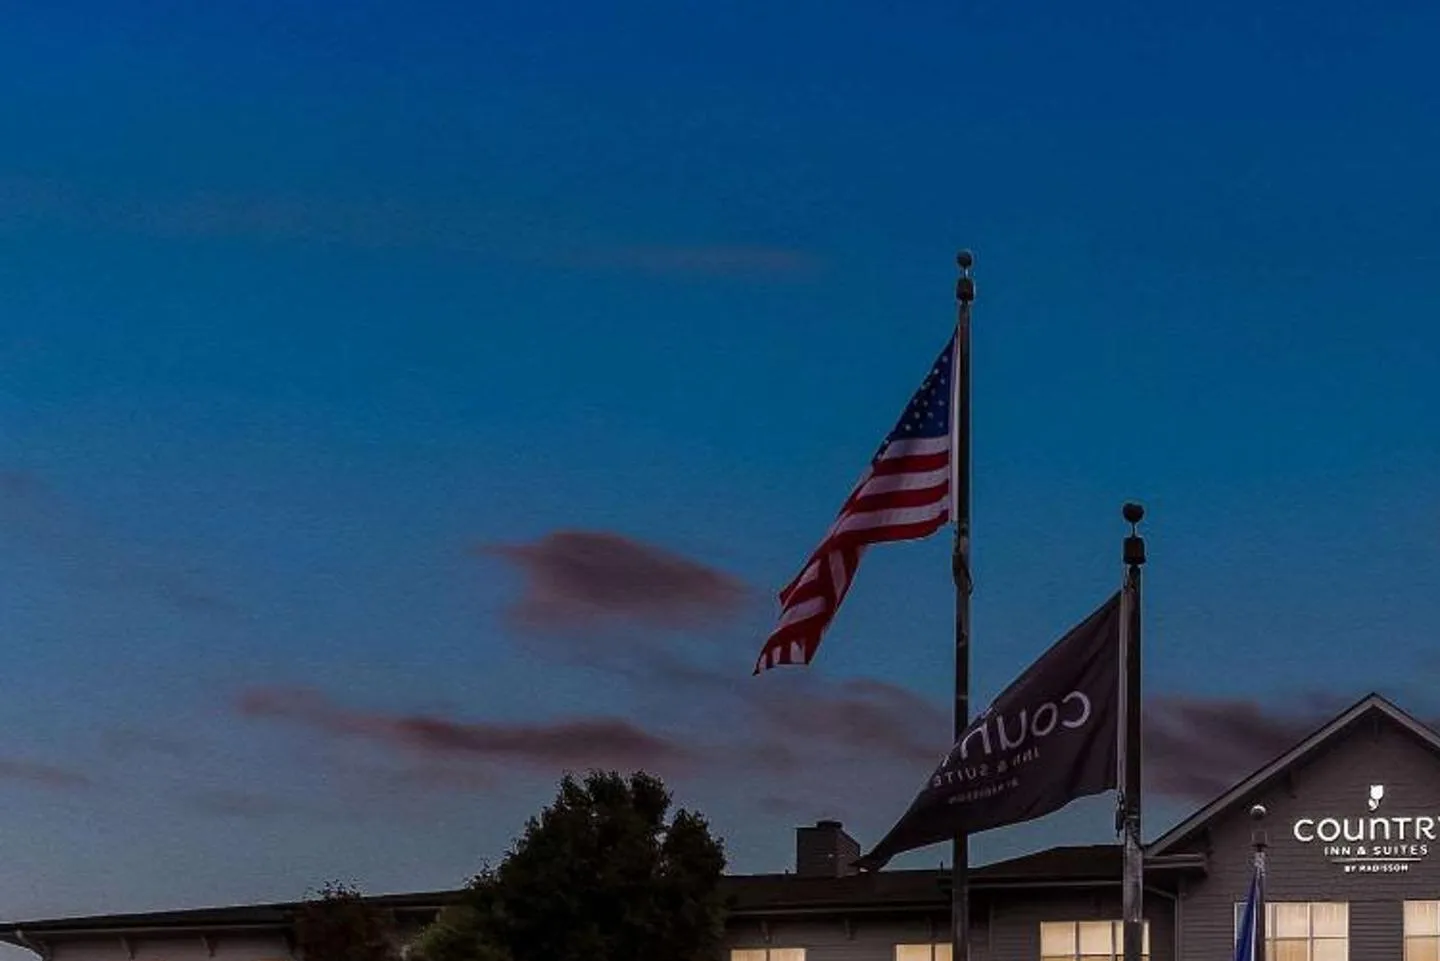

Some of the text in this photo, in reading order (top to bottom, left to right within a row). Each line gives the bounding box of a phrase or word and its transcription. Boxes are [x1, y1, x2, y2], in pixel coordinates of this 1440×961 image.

[1323, 844, 1428, 856] INN & SUITES
[1358, 864, 1409, 873] RADISSON
